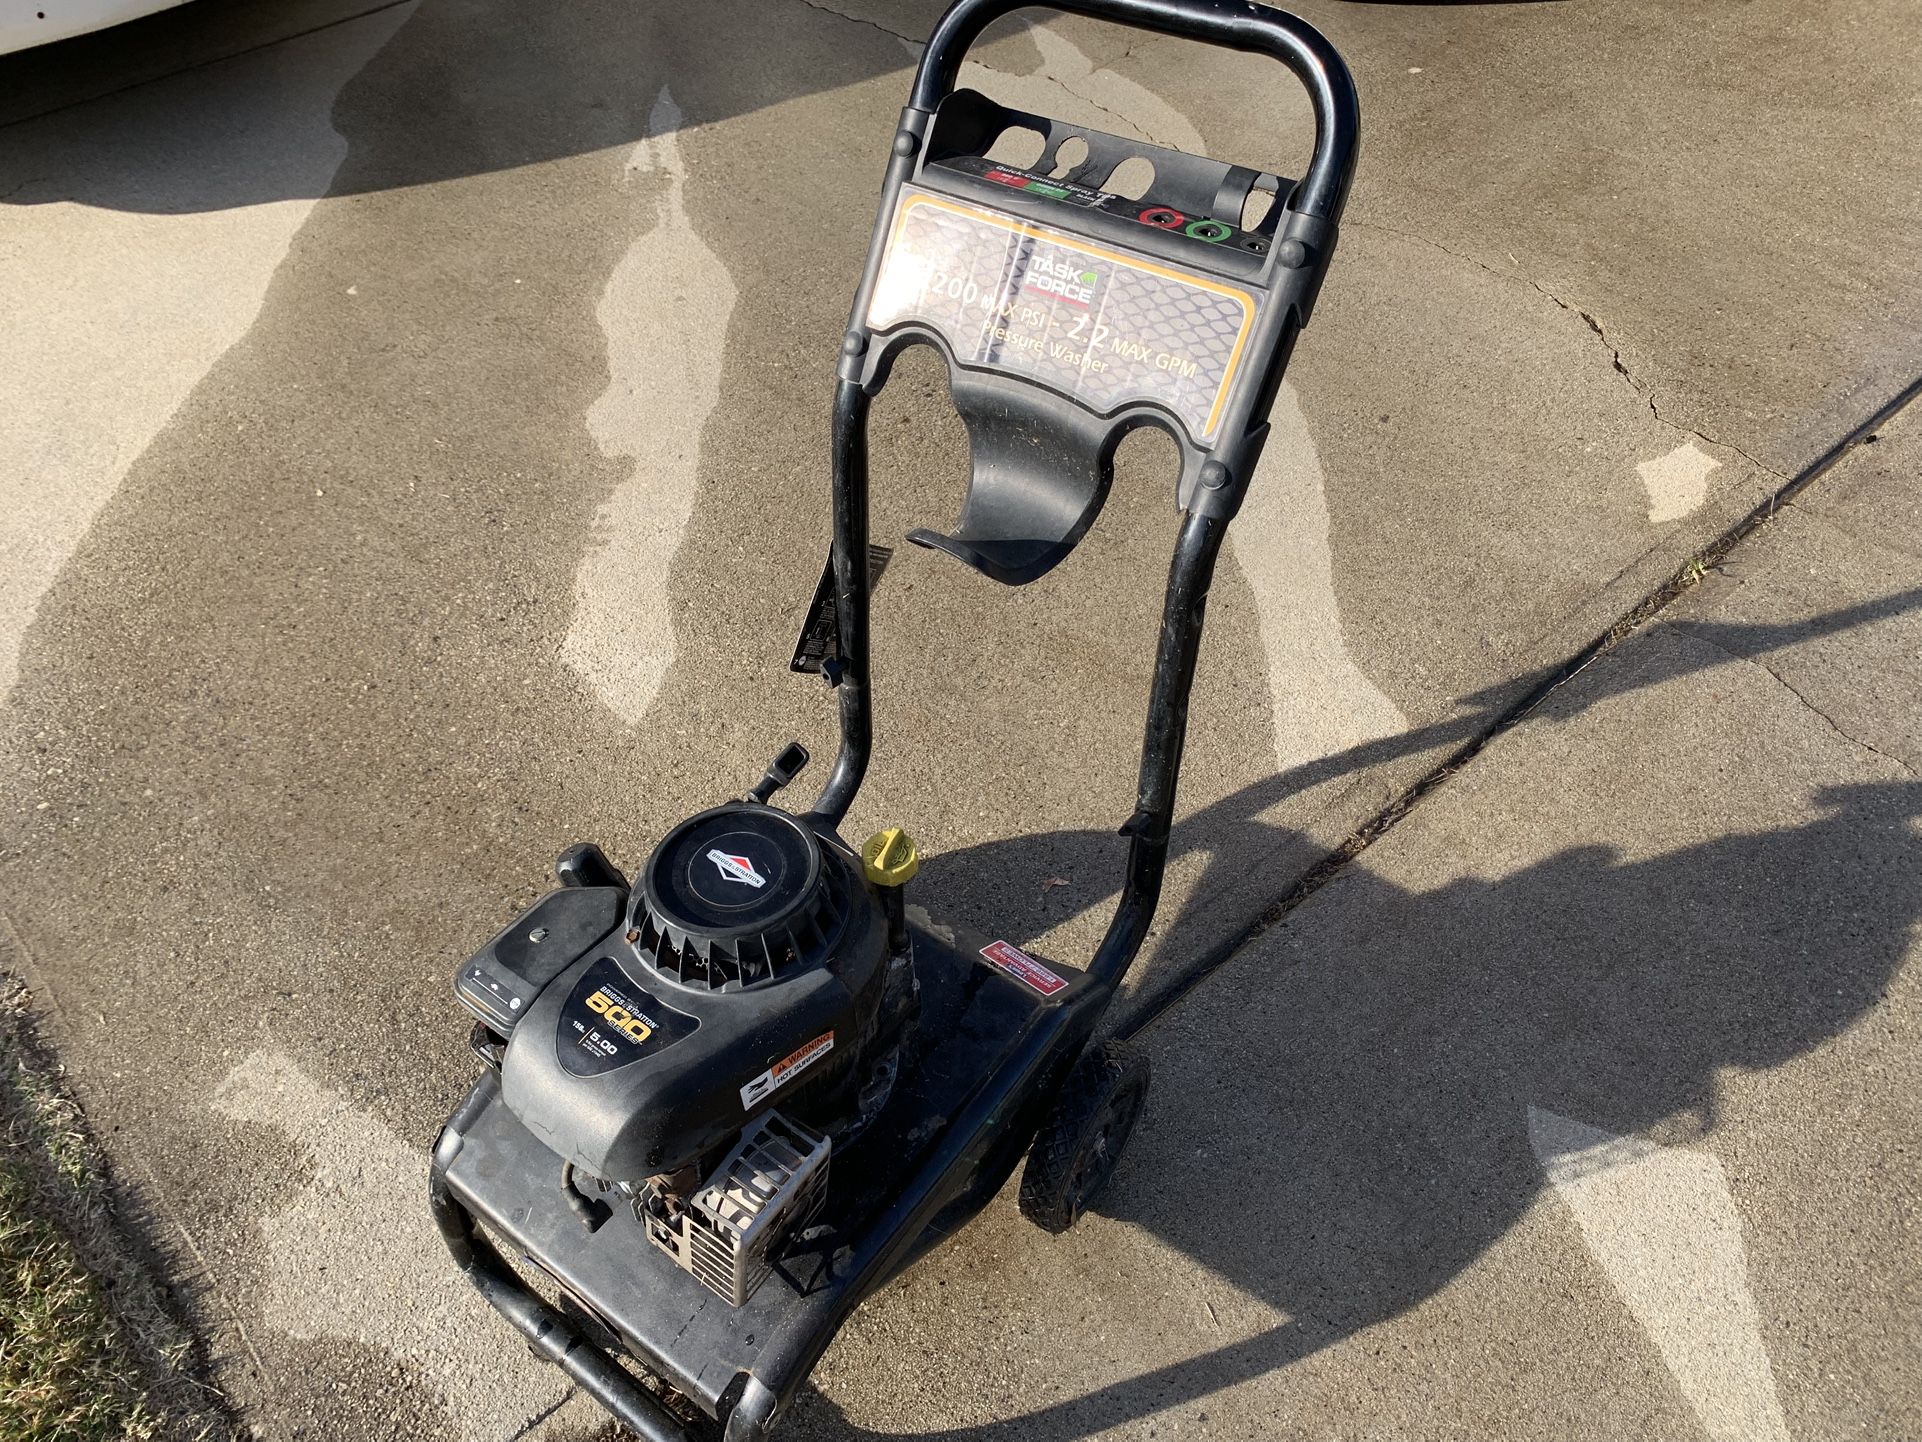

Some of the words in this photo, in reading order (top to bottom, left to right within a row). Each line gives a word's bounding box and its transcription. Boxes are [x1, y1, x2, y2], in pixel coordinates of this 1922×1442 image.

[996, 165, 1065, 187] Quick-Connect
[1066, 184, 1094, 196] Spray
[1031, 255, 1083, 284] TASK
[1024, 271, 1093, 304] FORCE
[980, 294, 1018, 318] MAX
[1021, 307, 1046, 328] PSI
[1067, 315, 1109, 349] 2.2
[1111, 337, 1152, 363] MAX
[1155, 353, 1198, 379] GPM
[984, 319, 1044, 353] Pressure
[1050, 341, 1110, 374] Washer
[600, 986, 625, 1007] BRIGGS
[625, 1005, 658, 1029] STRATTON
[590, 1032, 618, 1055] 5.00
[788, 1035, 830, 1063] WARNING
[777, 1072, 792, 1084] HOT
[794, 1043, 831, 1071] SURFACES
